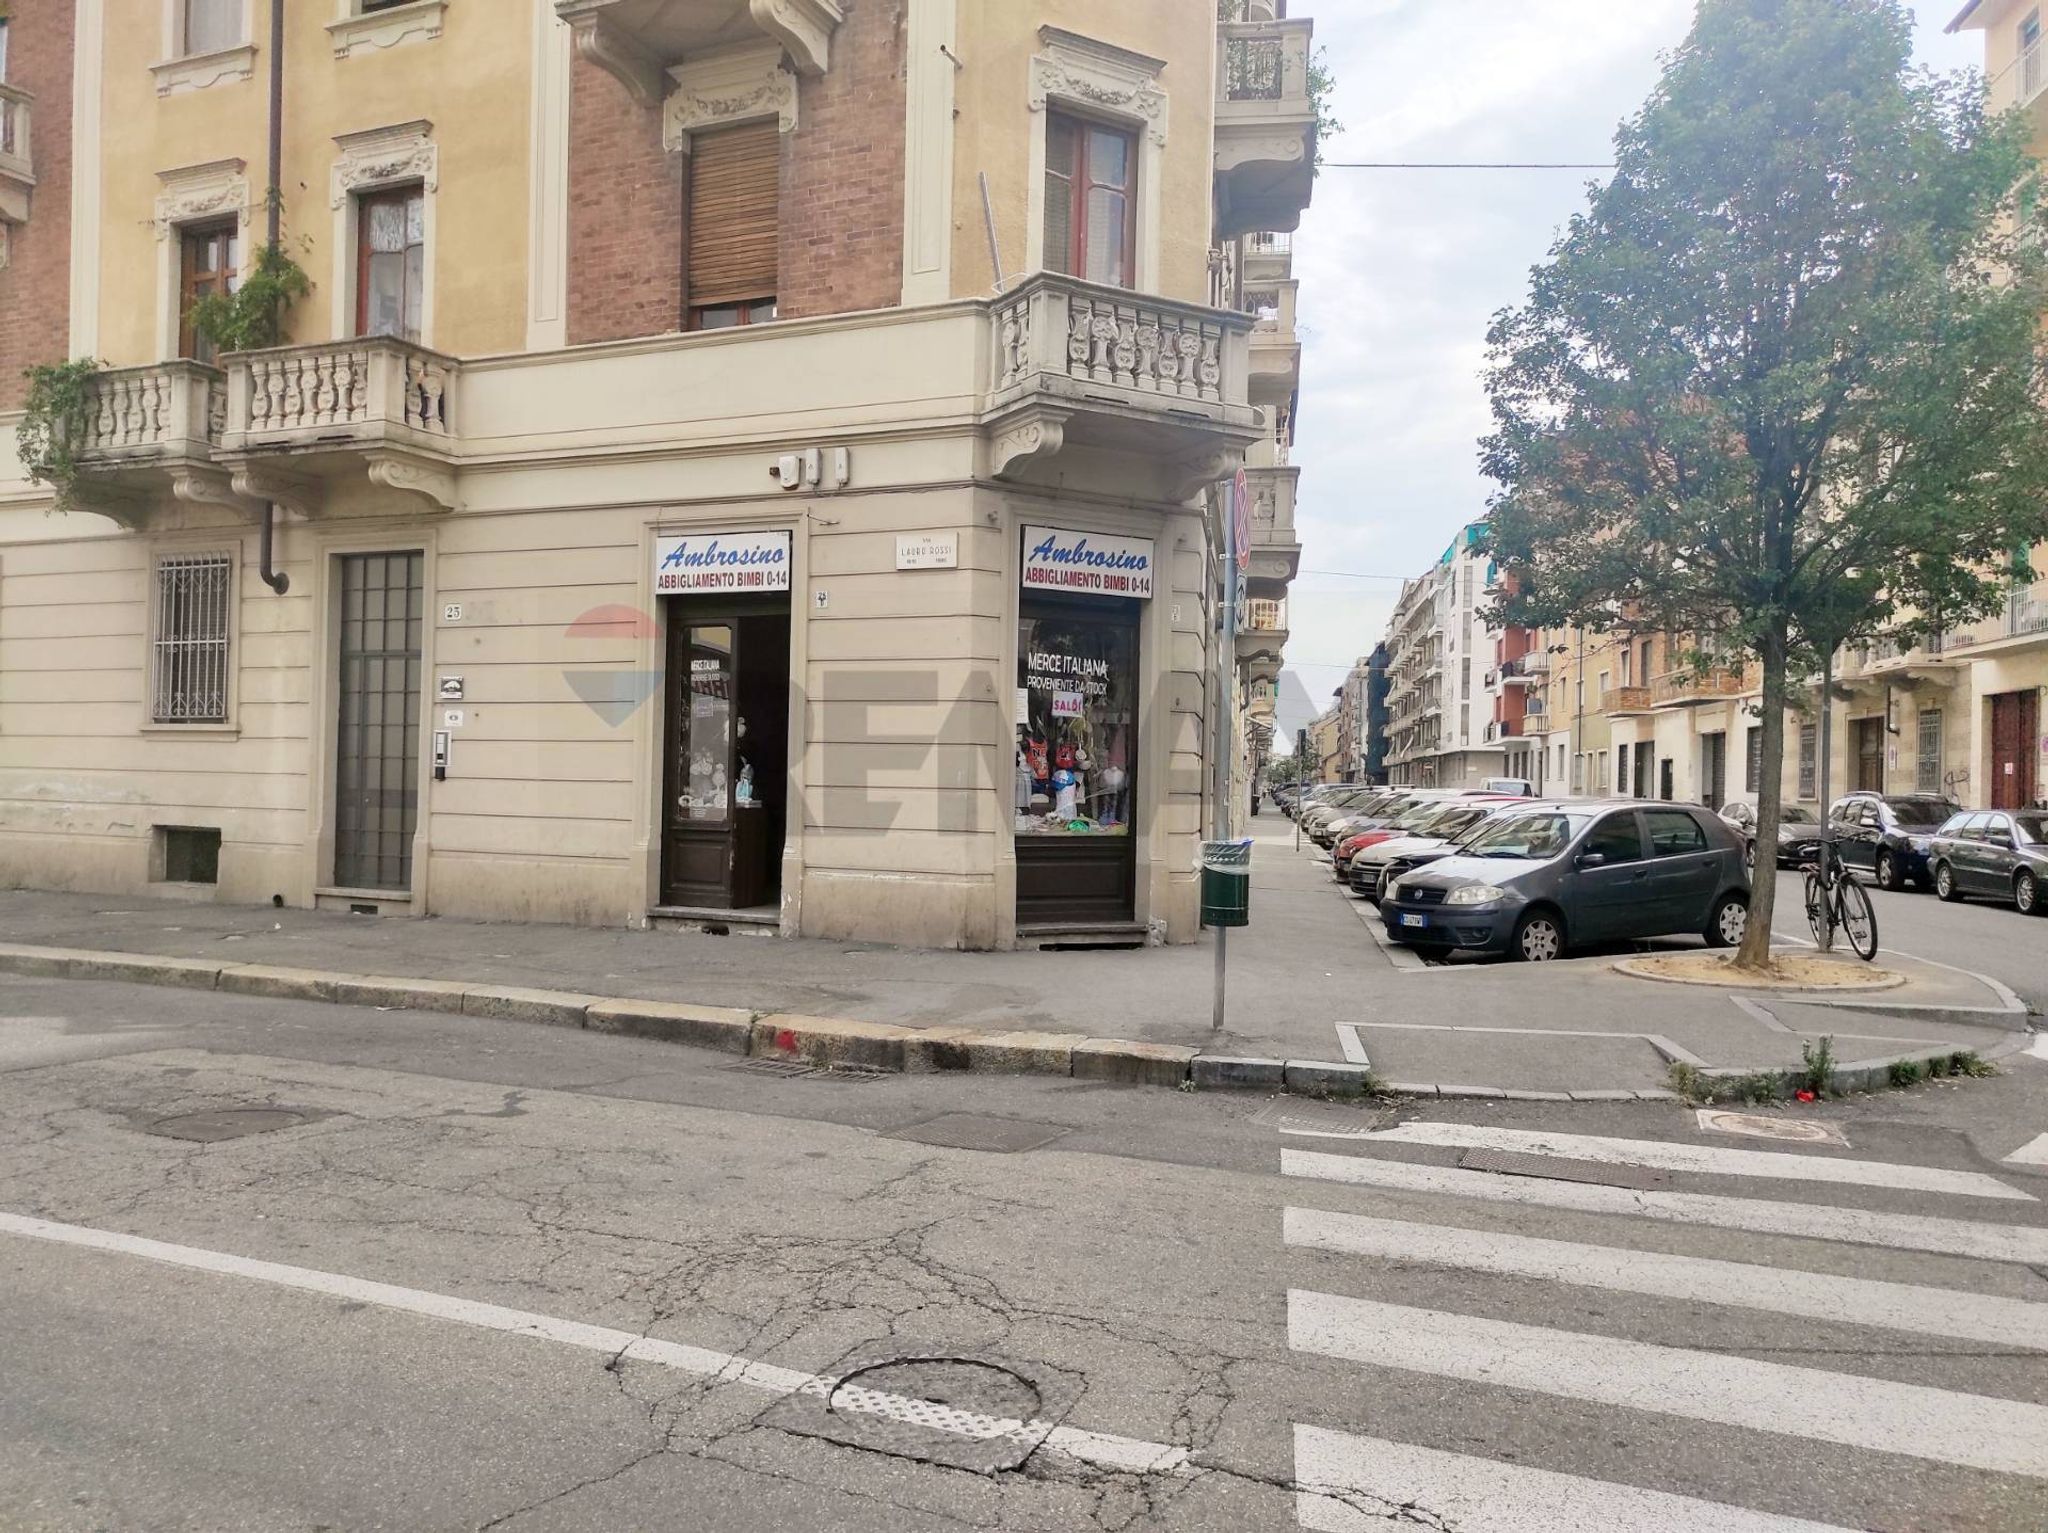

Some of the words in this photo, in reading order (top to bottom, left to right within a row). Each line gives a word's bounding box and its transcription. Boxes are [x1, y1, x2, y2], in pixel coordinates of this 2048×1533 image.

[661, 540, 785, 570] Ambrosino
[929, 544, 952, 555] ROSSI
[1028, 534, 1148, 571] Ambrosino
[658, 571, 735, 589] ABBIGLIAMENTO
[737, 571, 764, 587] BIMBI
[766, 570, 787, 586] 0-14
[1025, 566, 1102, 590] ABBIGLIAMENTO
[1103, 574, 1129, 591] BIMBI
[1131, 577, 1150, 593] 0-14
[447, 607, 461, 618] 25
[1028, 652, 1062, 673] MERCE
[1063, 655, 1108, 678] ITALIANA
[1027, 675, 1074, 691] PROVENIENTE
[1075, 680, 1084, 693] DA
[1085, 681, 1107, 695] STOCK
